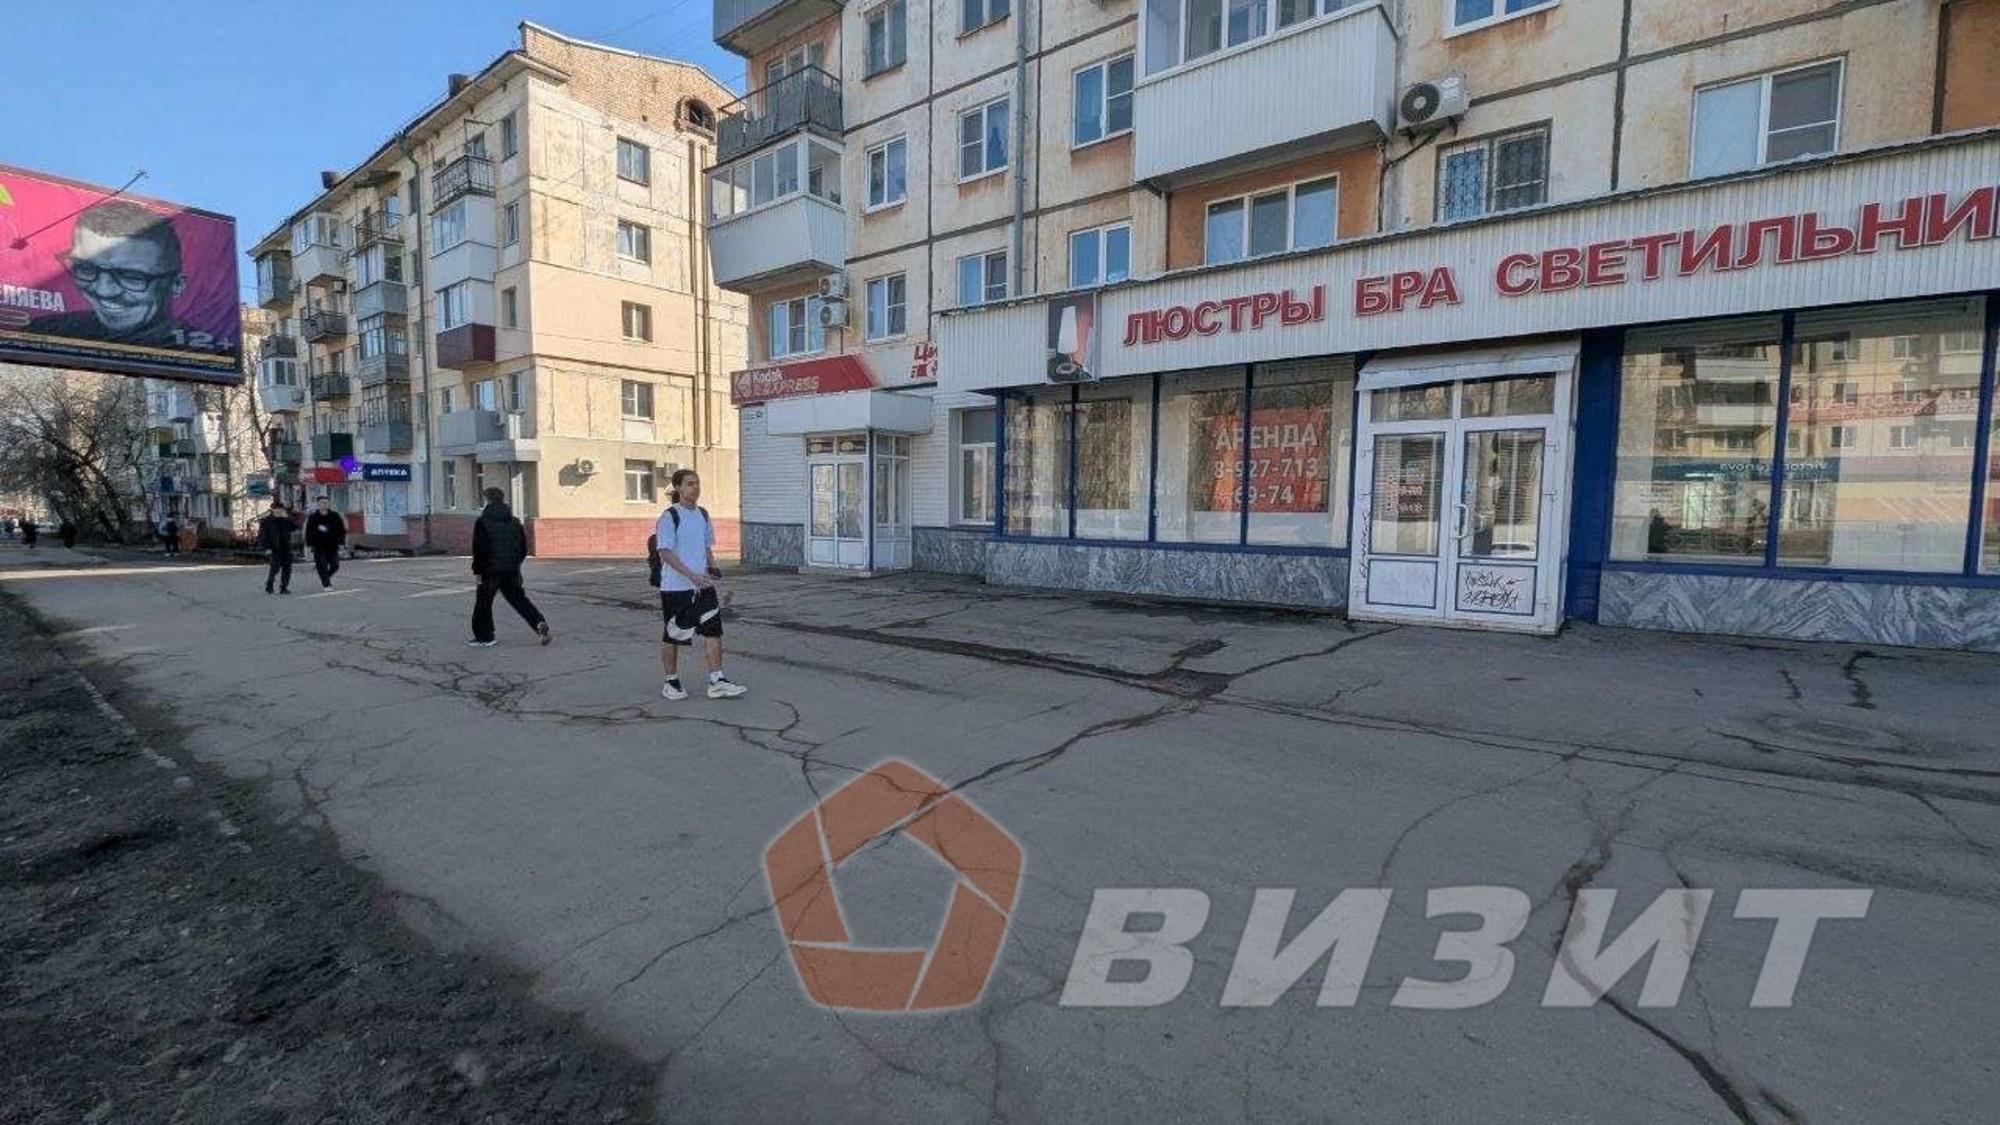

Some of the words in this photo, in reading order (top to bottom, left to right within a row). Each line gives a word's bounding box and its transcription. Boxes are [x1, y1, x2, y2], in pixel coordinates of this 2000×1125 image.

[1123, 284, 1326, 346] ЛЮСТРЫ
[1354, 265, 1460, 317] БРА
[1495, 185, 2000, 296] СВЕТИЛЬНИ
[173, 328, 235, 351] 12+
[752, 368, 784, 384] Kodak
[1215, 422, 1318, 453] АРЕНДА
